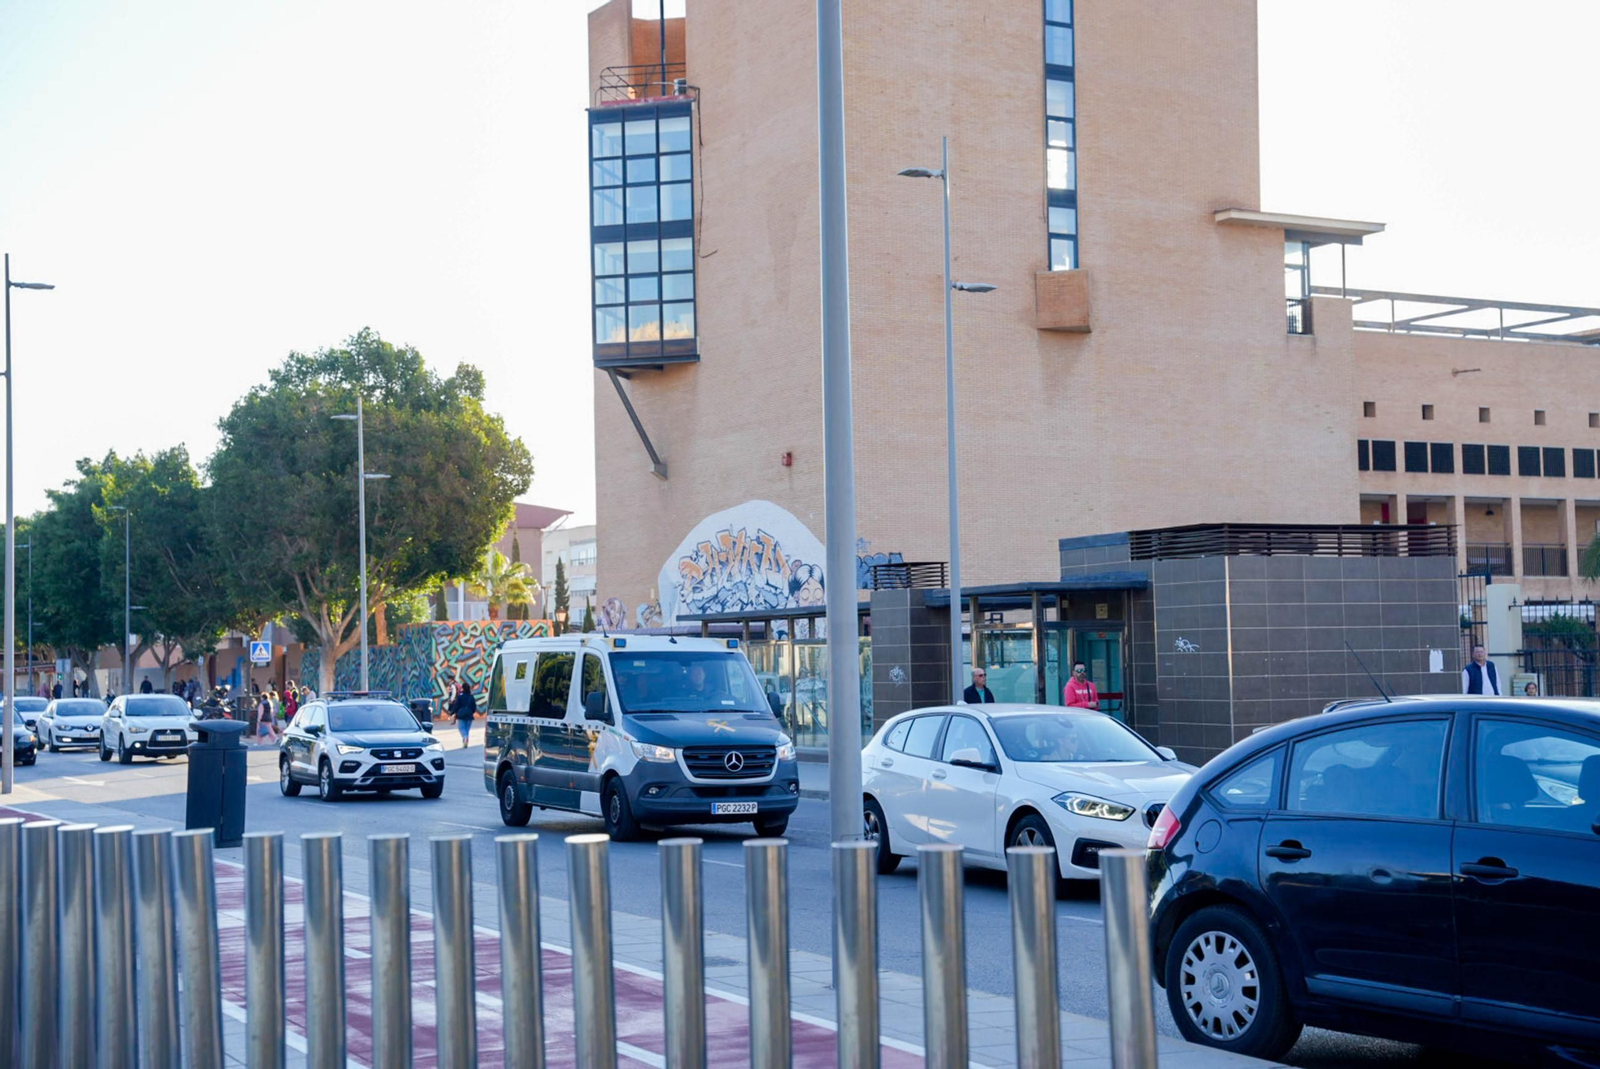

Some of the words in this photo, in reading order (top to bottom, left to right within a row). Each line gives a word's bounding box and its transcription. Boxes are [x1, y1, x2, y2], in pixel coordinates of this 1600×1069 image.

[717, 804, 731, 812] PGC
[733, 804, 751, 812] 2232
[752, 803, 756, 812] P
